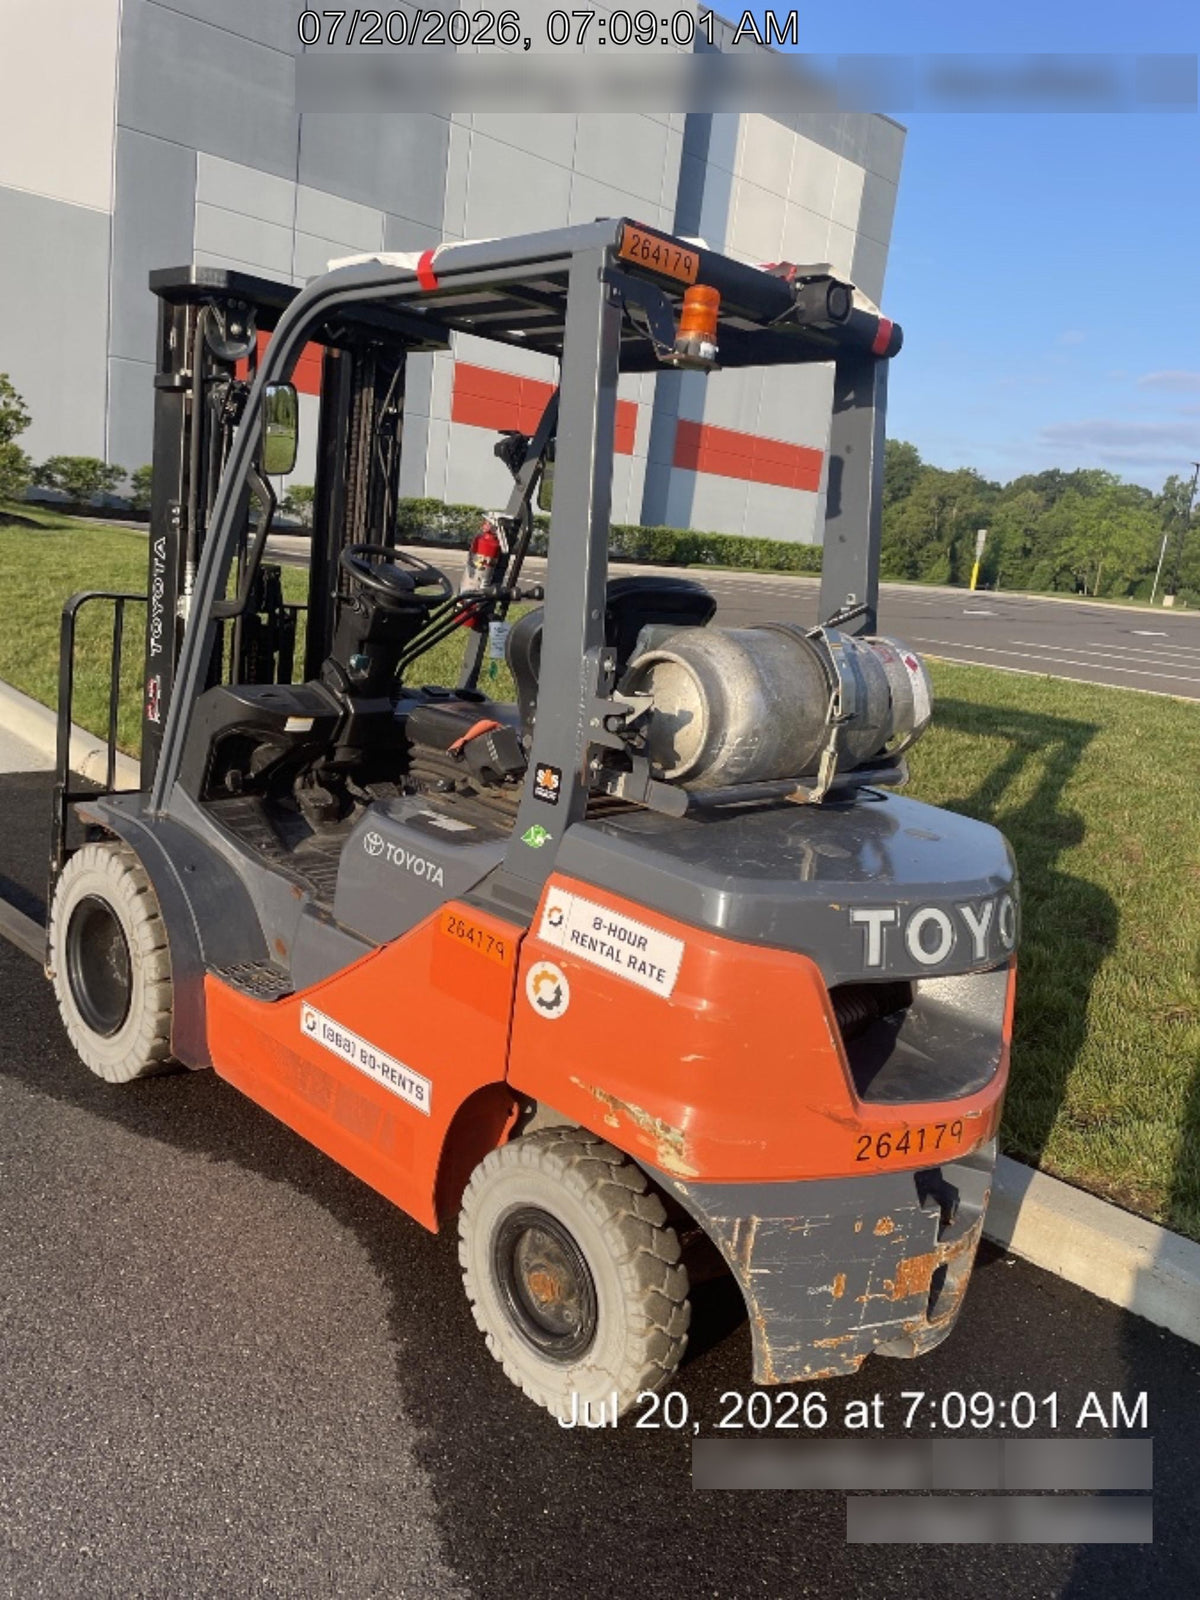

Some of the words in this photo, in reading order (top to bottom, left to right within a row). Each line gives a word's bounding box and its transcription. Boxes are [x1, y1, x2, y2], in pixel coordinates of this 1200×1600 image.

[630, 234, 692, 275] 264179
[150, 536, 166, 657] TOYOTA
[386, 842, 444, 888] TOYOTA
[447, 916, 504, 961] 264179
[570, 929, 623, 964] RENTAL
[626, 955, 667, 984] RATE
[591, 916, 649, 952] 8-HOUR
[856, 1120, 963, 1161] 264179
